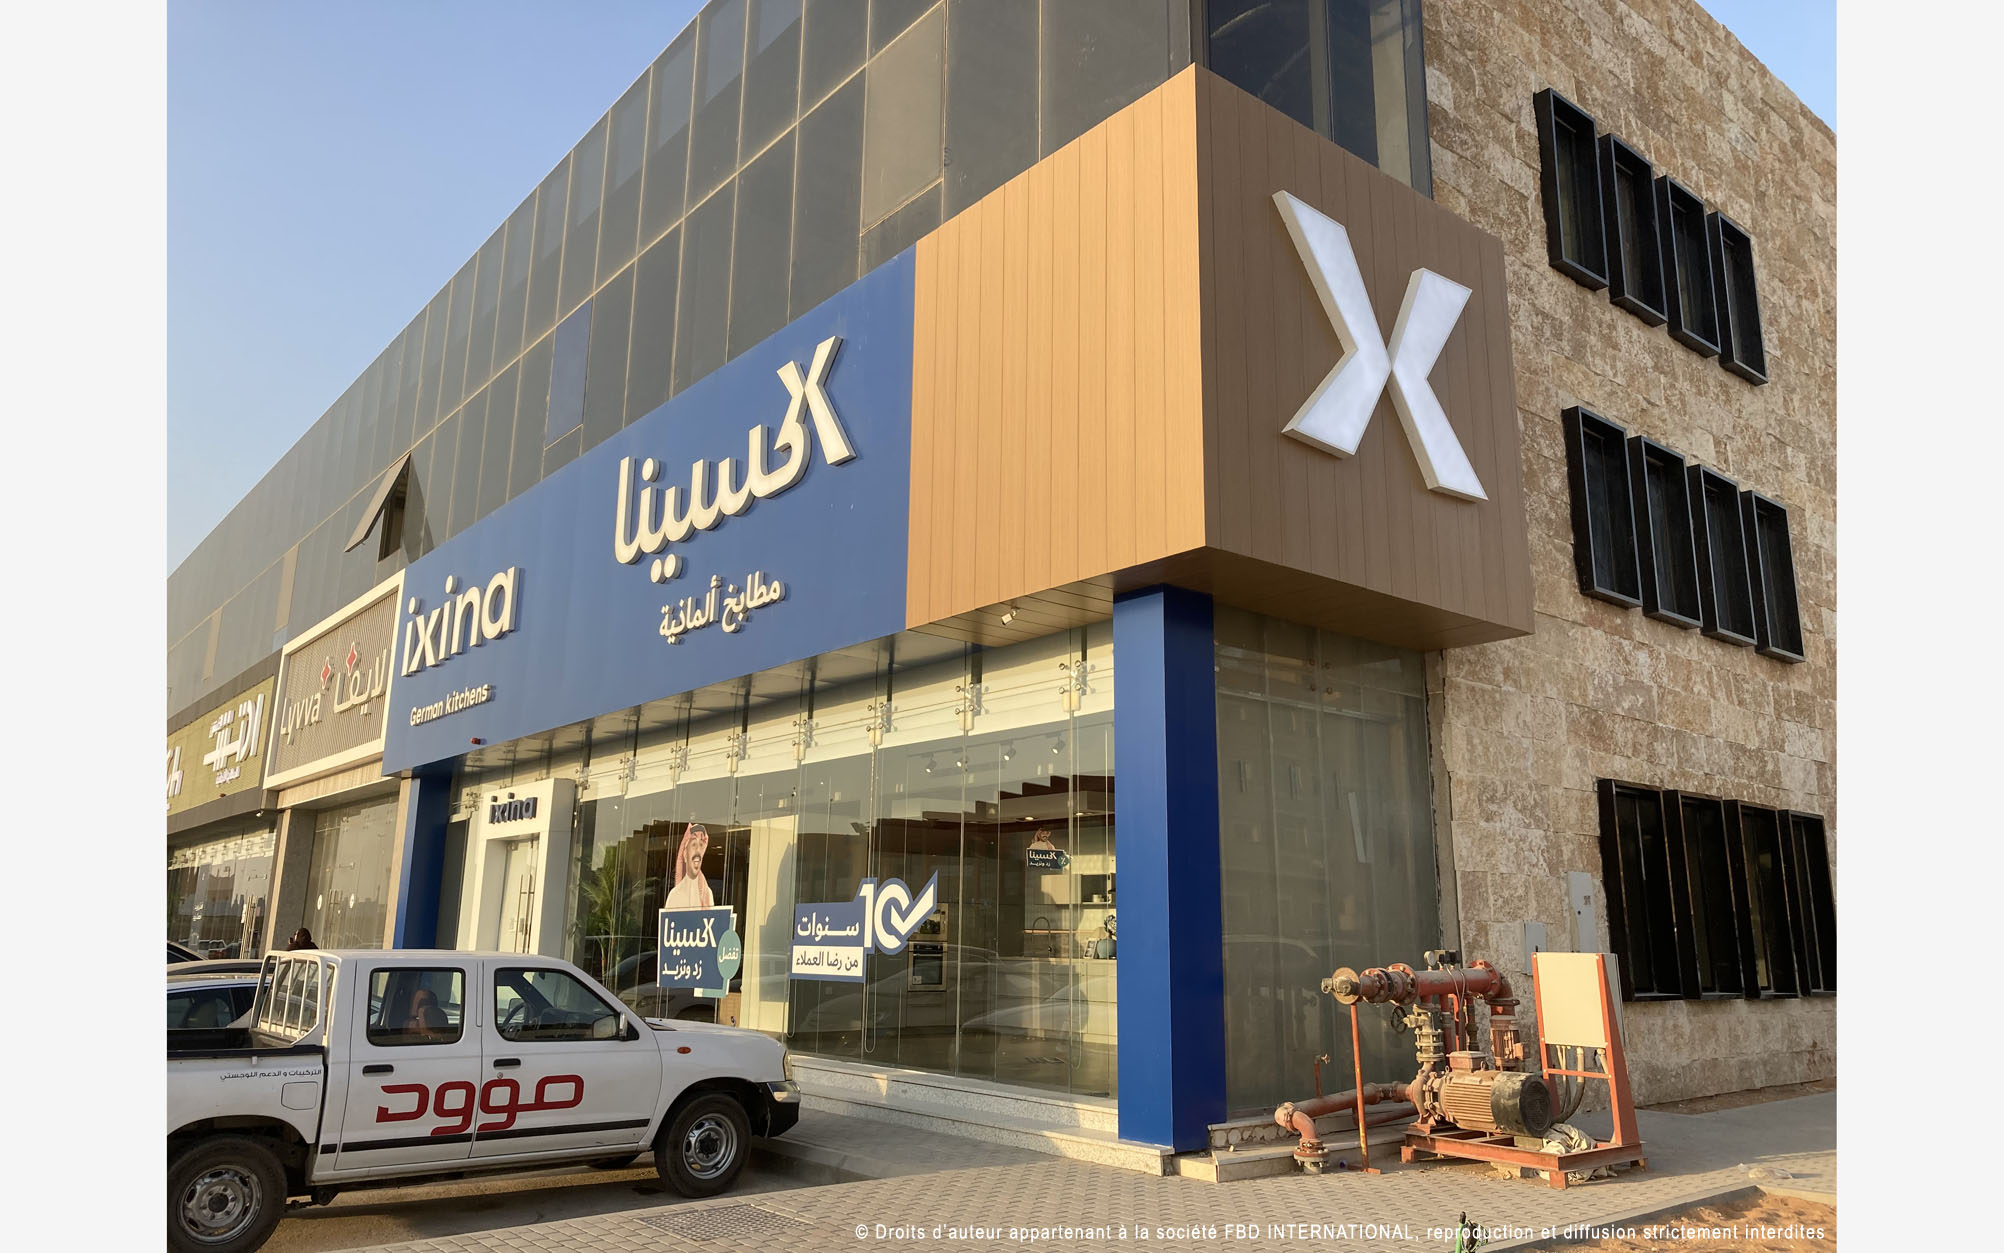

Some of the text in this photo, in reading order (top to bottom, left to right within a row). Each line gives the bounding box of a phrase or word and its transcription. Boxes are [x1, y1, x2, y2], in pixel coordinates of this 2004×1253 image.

[402, 566, 520, 677] ixina
[659, 570, 785, 645] مطابخ ألمانية
[410, 684, 493, 726] German kitchens
[489, 792, 538, 824] ixina
[797, 911, 860, 942] سنوات
[692, 959, 703, 980] زد
[796, 950, 859, 972] من رضا العملاء
[259, 1070, 282, 1079] الدعم
